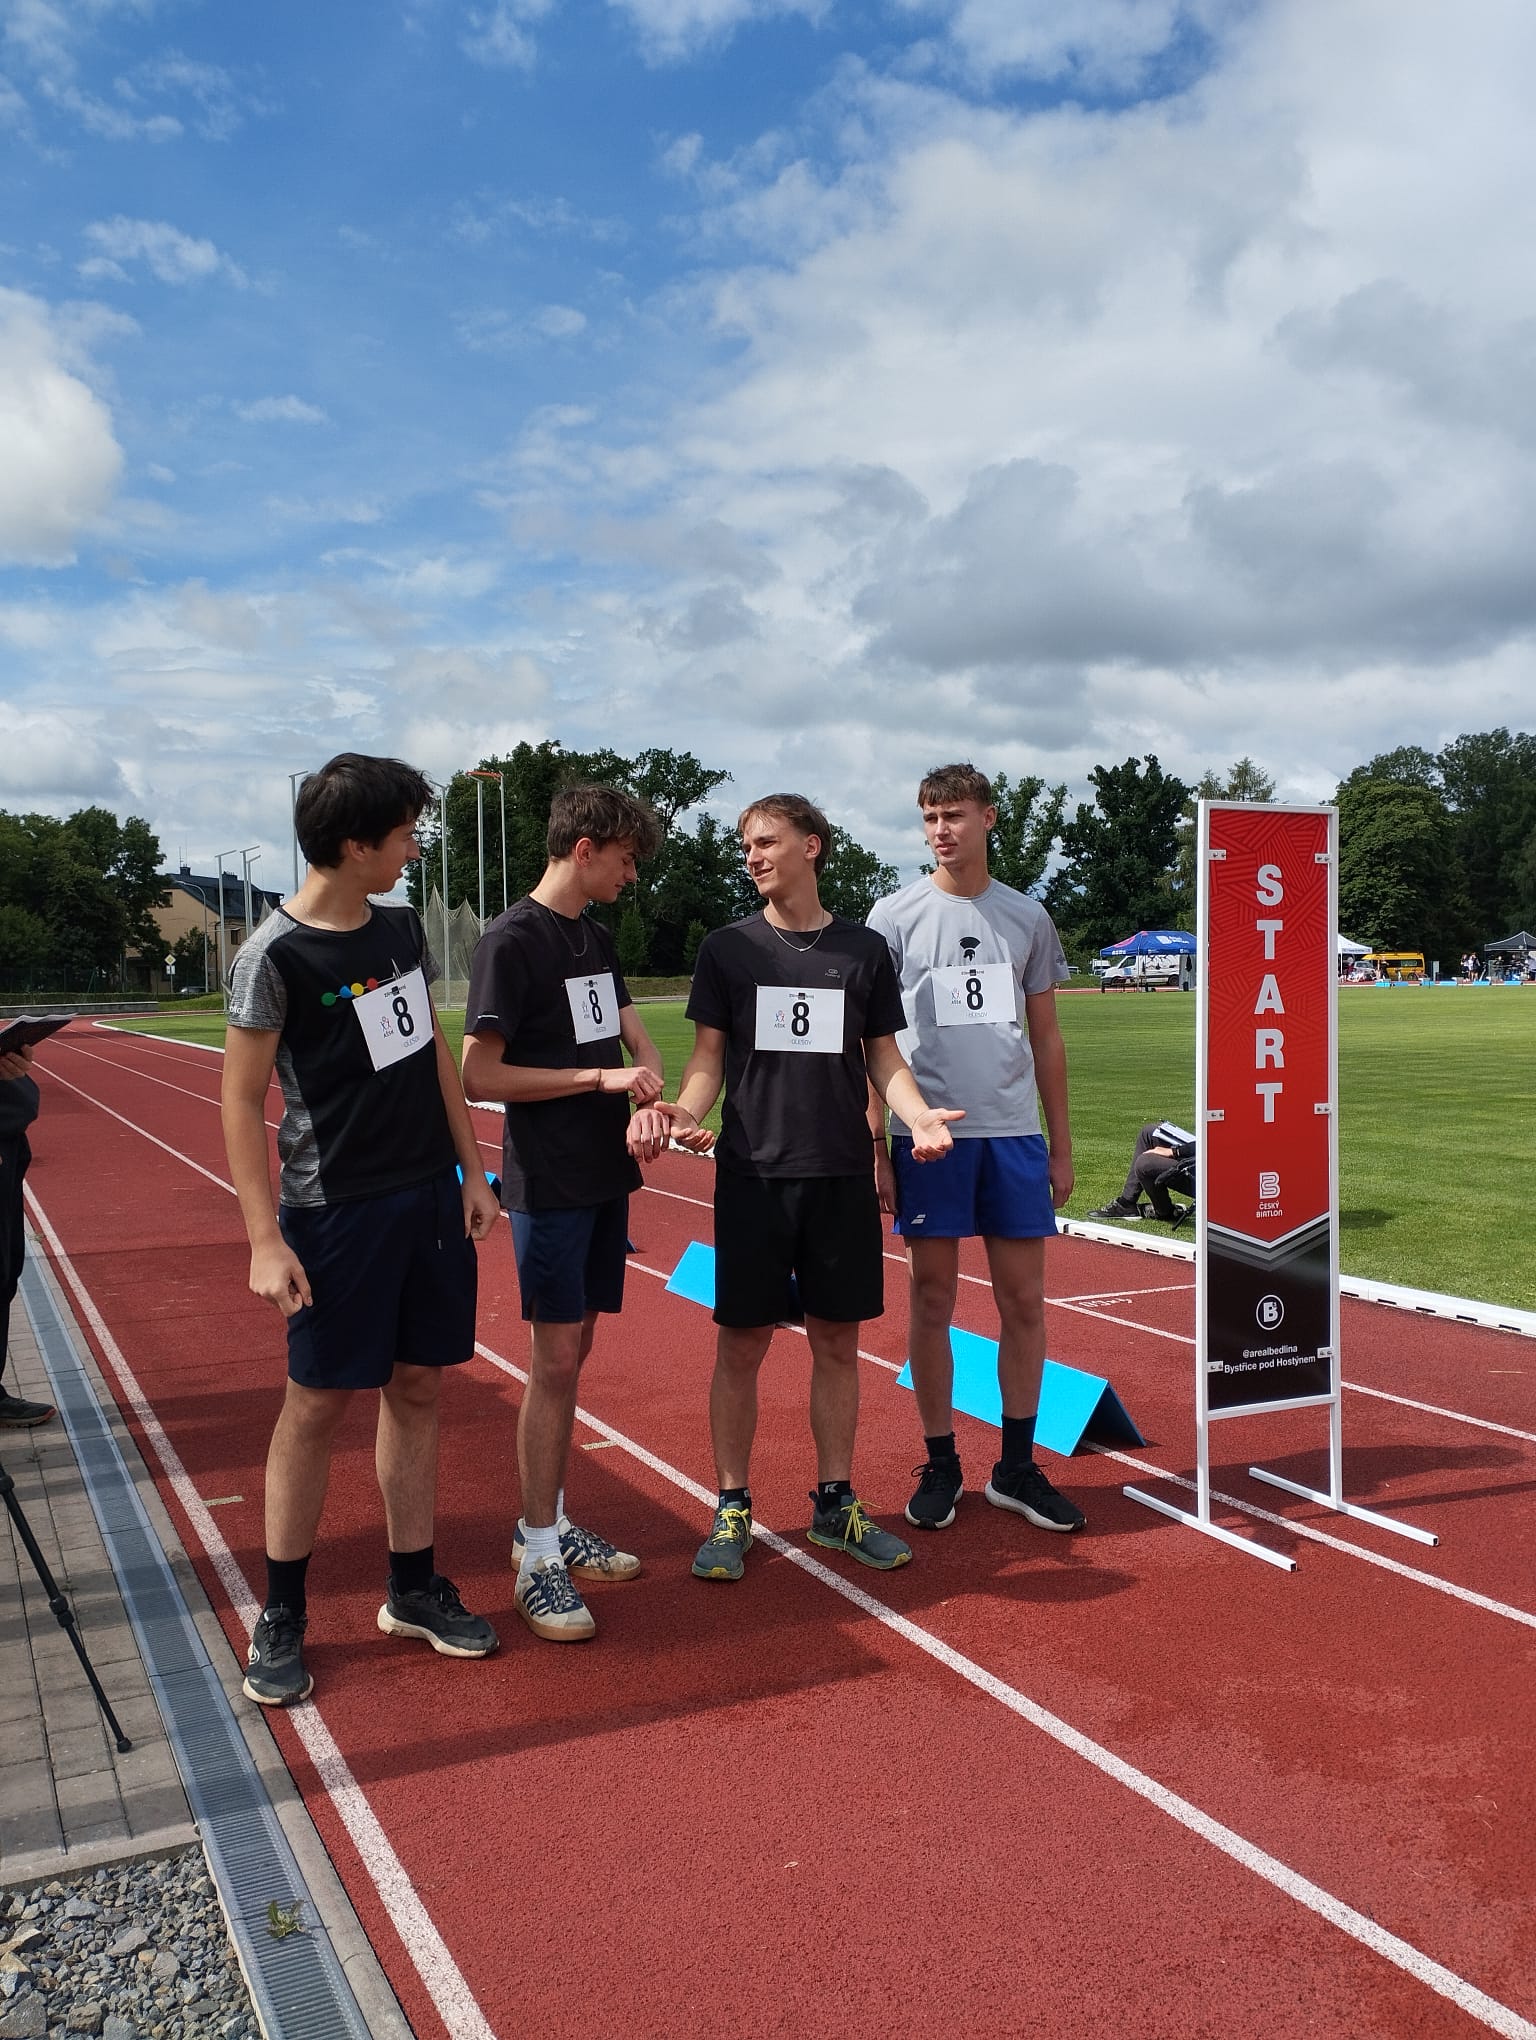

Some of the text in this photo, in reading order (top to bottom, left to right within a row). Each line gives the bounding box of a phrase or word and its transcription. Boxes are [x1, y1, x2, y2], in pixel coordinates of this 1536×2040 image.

[588, 989, 603, 1025] 8
[966, 977, 984, 1011] 8
[1254, 864, 1285, 1123] START
[392, 996, 415, 1038] 8
[791, 1001, 810, 1037] 8
[1256, 1209, 1283, 1218] BIATLON
[1259, 1200, 1280, 1210] ČESKÝ
[1224, 1355, 1316, 1375] Bystřice pod Hostýnem
[1242, 1345, 1298, 1359] @arealbedlina
